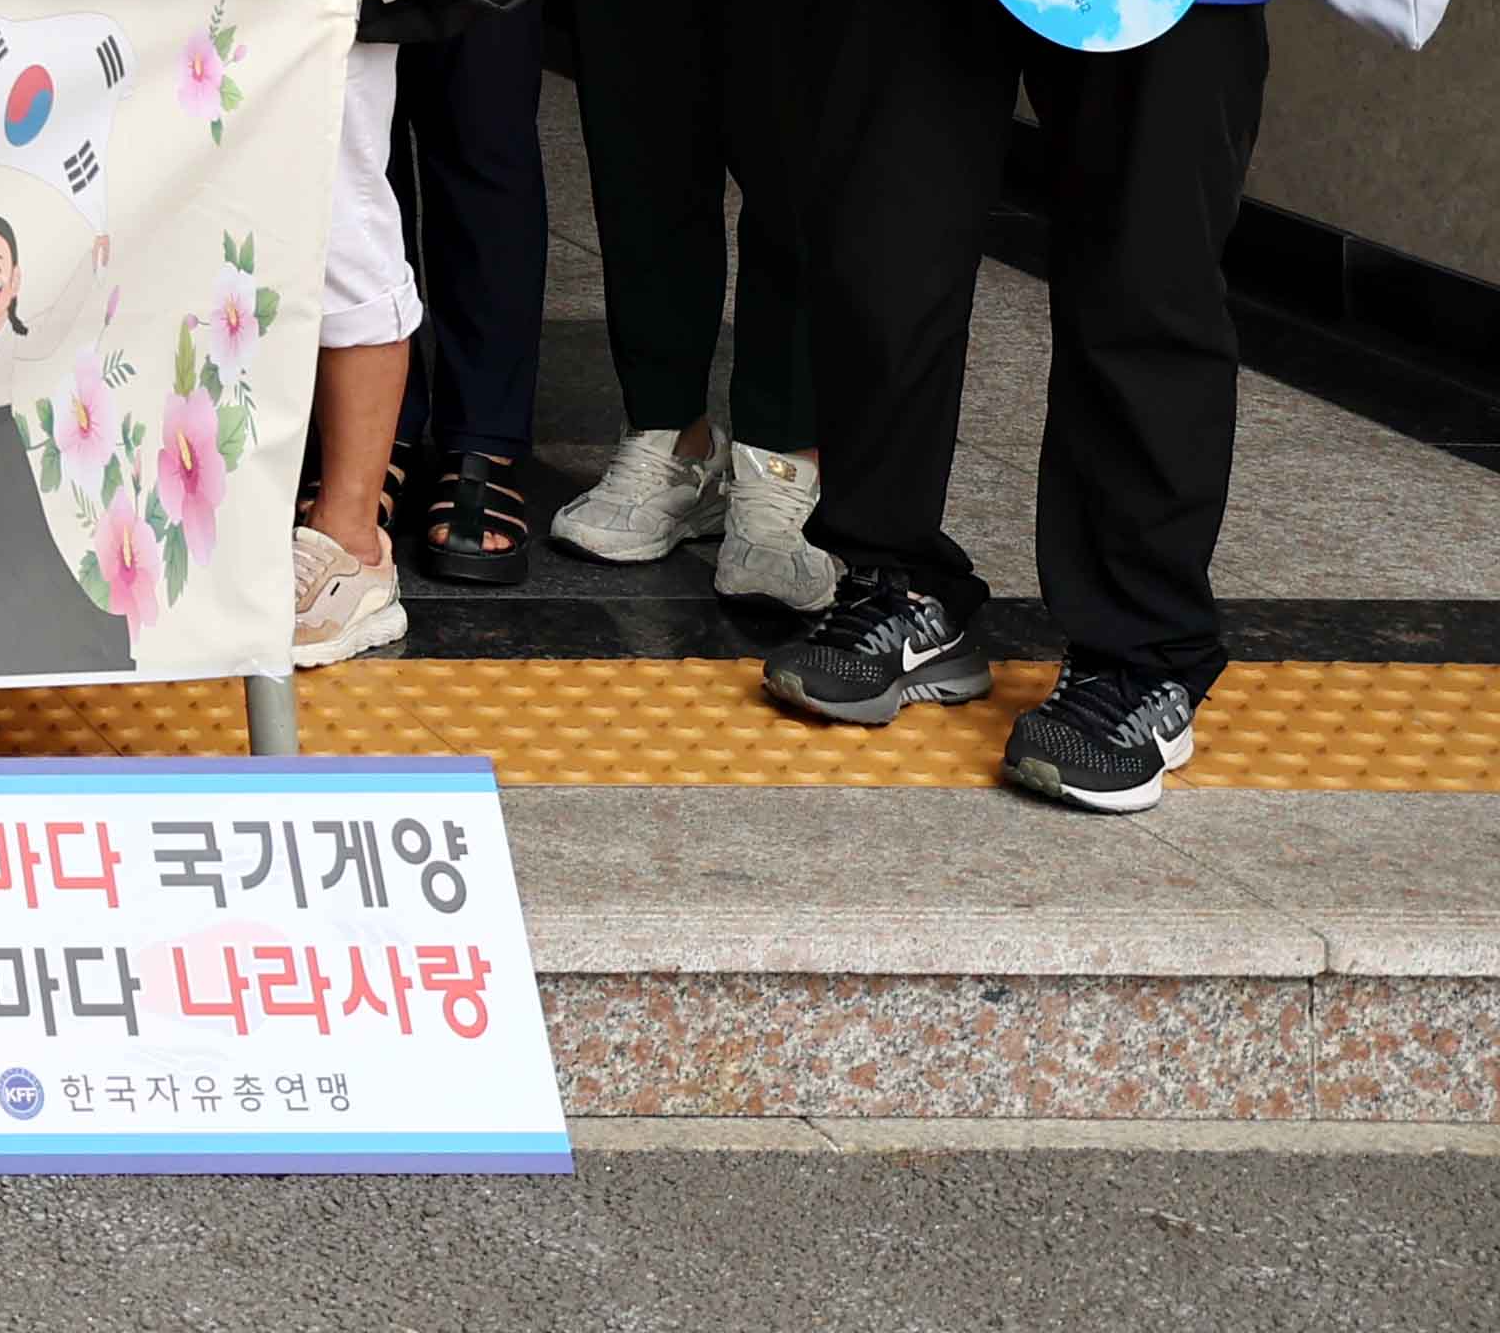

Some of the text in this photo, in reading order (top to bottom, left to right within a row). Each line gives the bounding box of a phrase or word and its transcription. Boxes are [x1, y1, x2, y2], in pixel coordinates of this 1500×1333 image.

[152, 819, 468, 913] 국기게양
[173, 946, 491, 1038] 나라사랑
[4, 1087, 37, 1103] KFF
[62, 1075, 349, 1111] 한국자유총연맹
